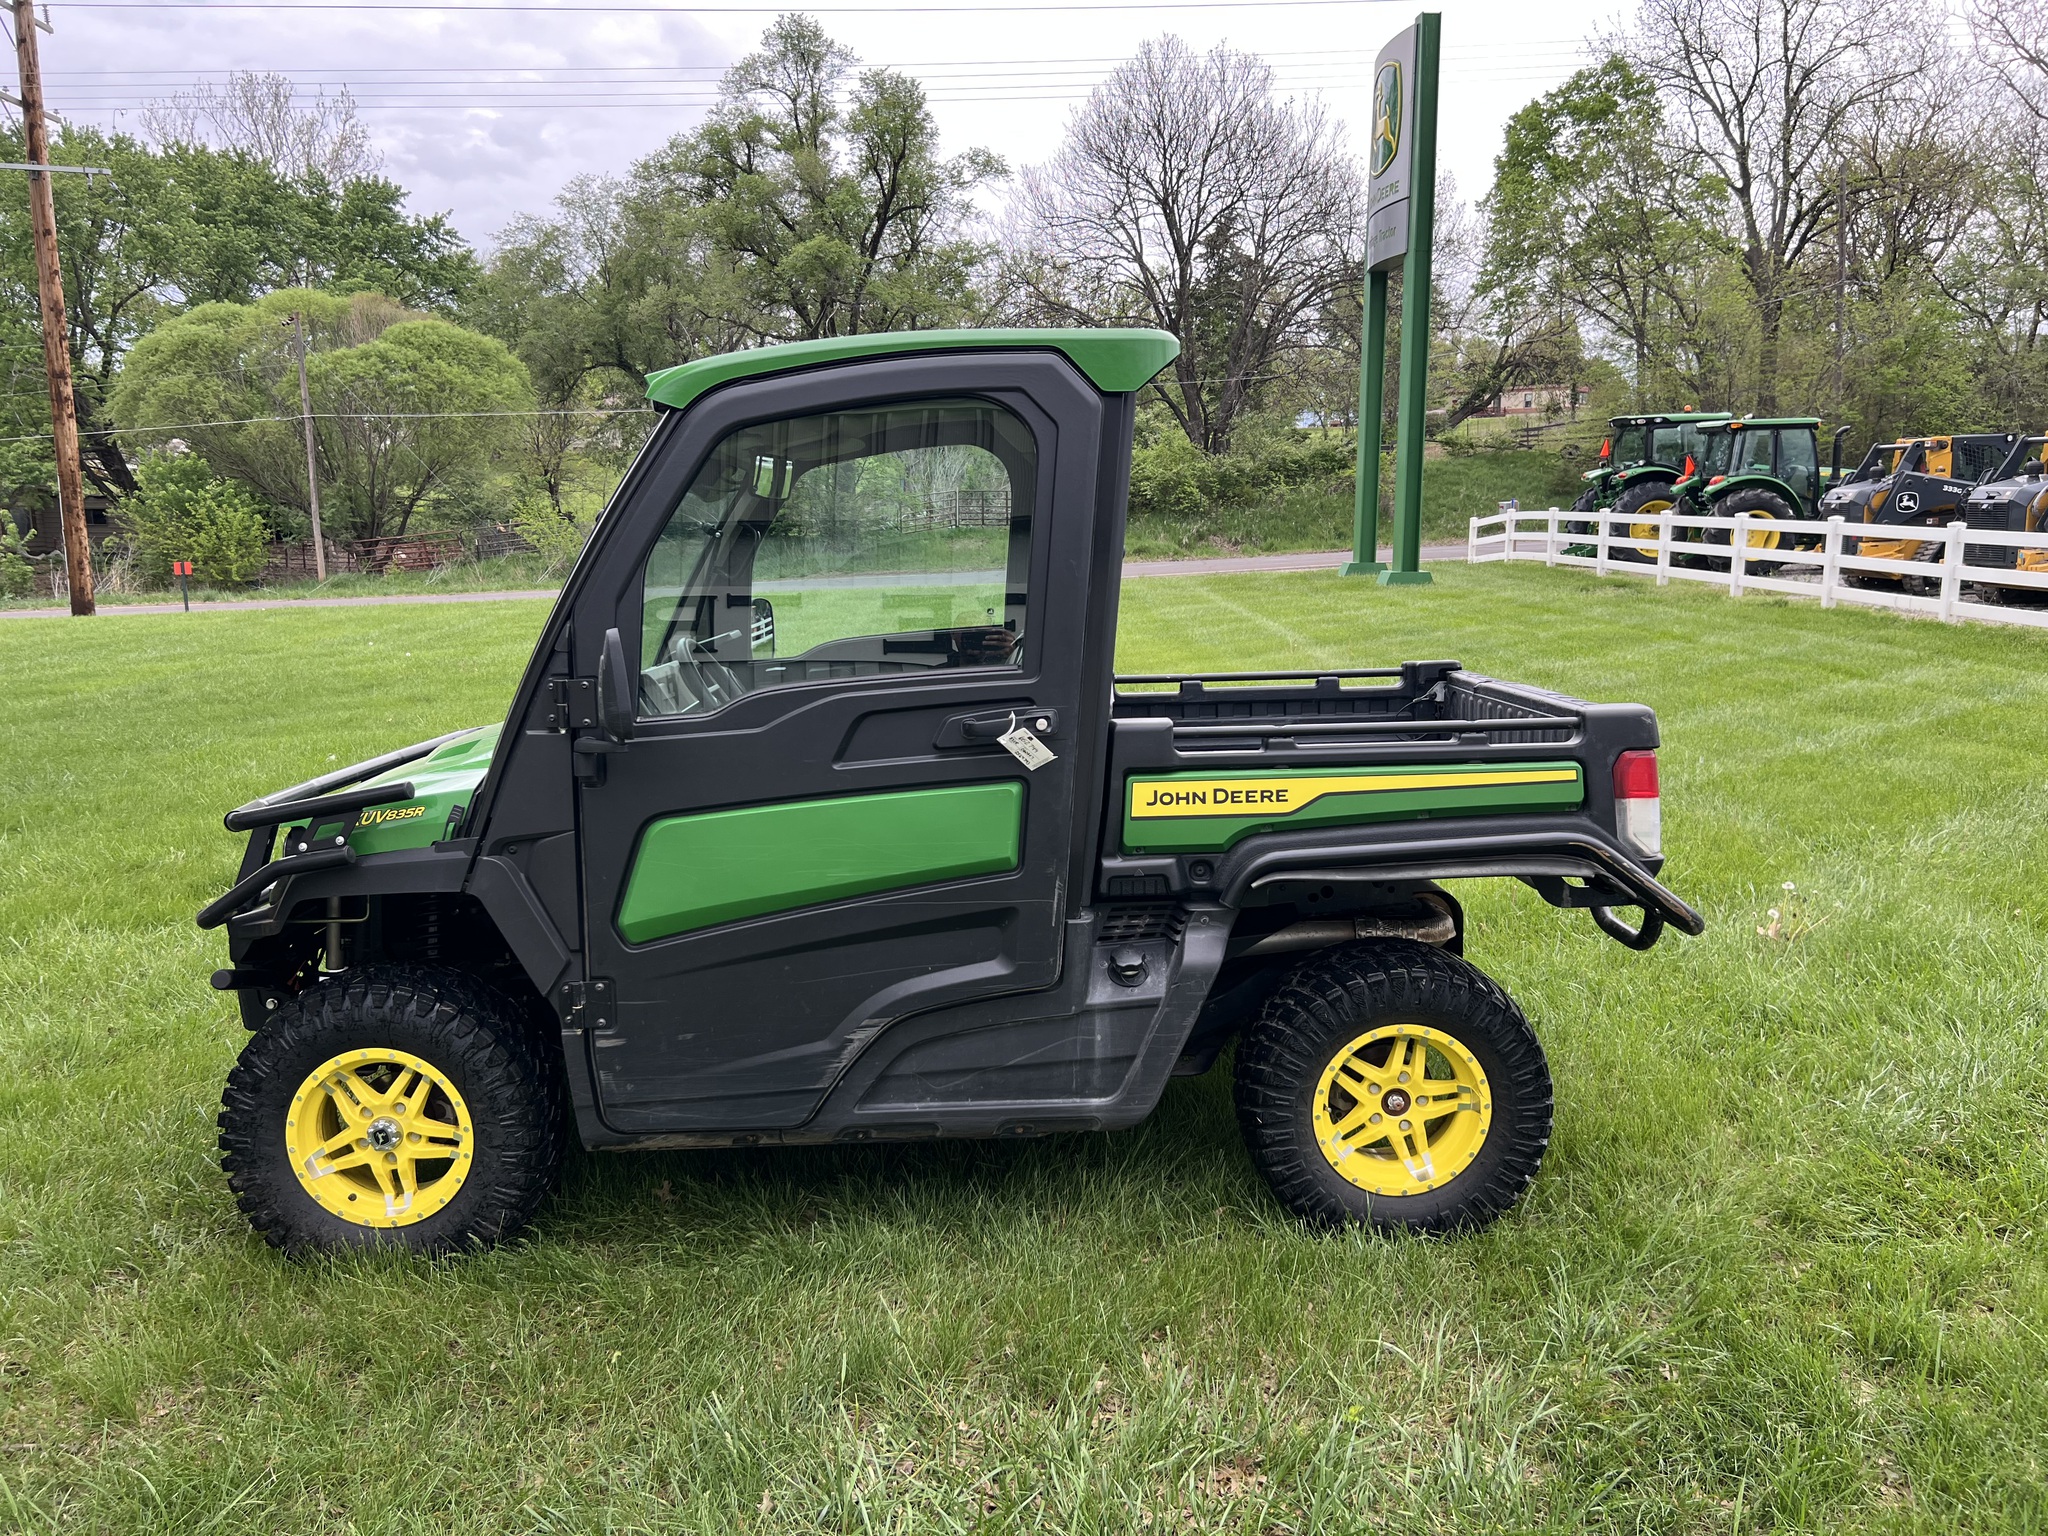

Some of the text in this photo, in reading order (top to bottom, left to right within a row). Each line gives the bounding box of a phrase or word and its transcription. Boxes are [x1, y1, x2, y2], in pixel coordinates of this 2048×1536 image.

[1943, 485, 1962, 494] 333G
[1146, 788, 1289, 806] JOHN DEERE
